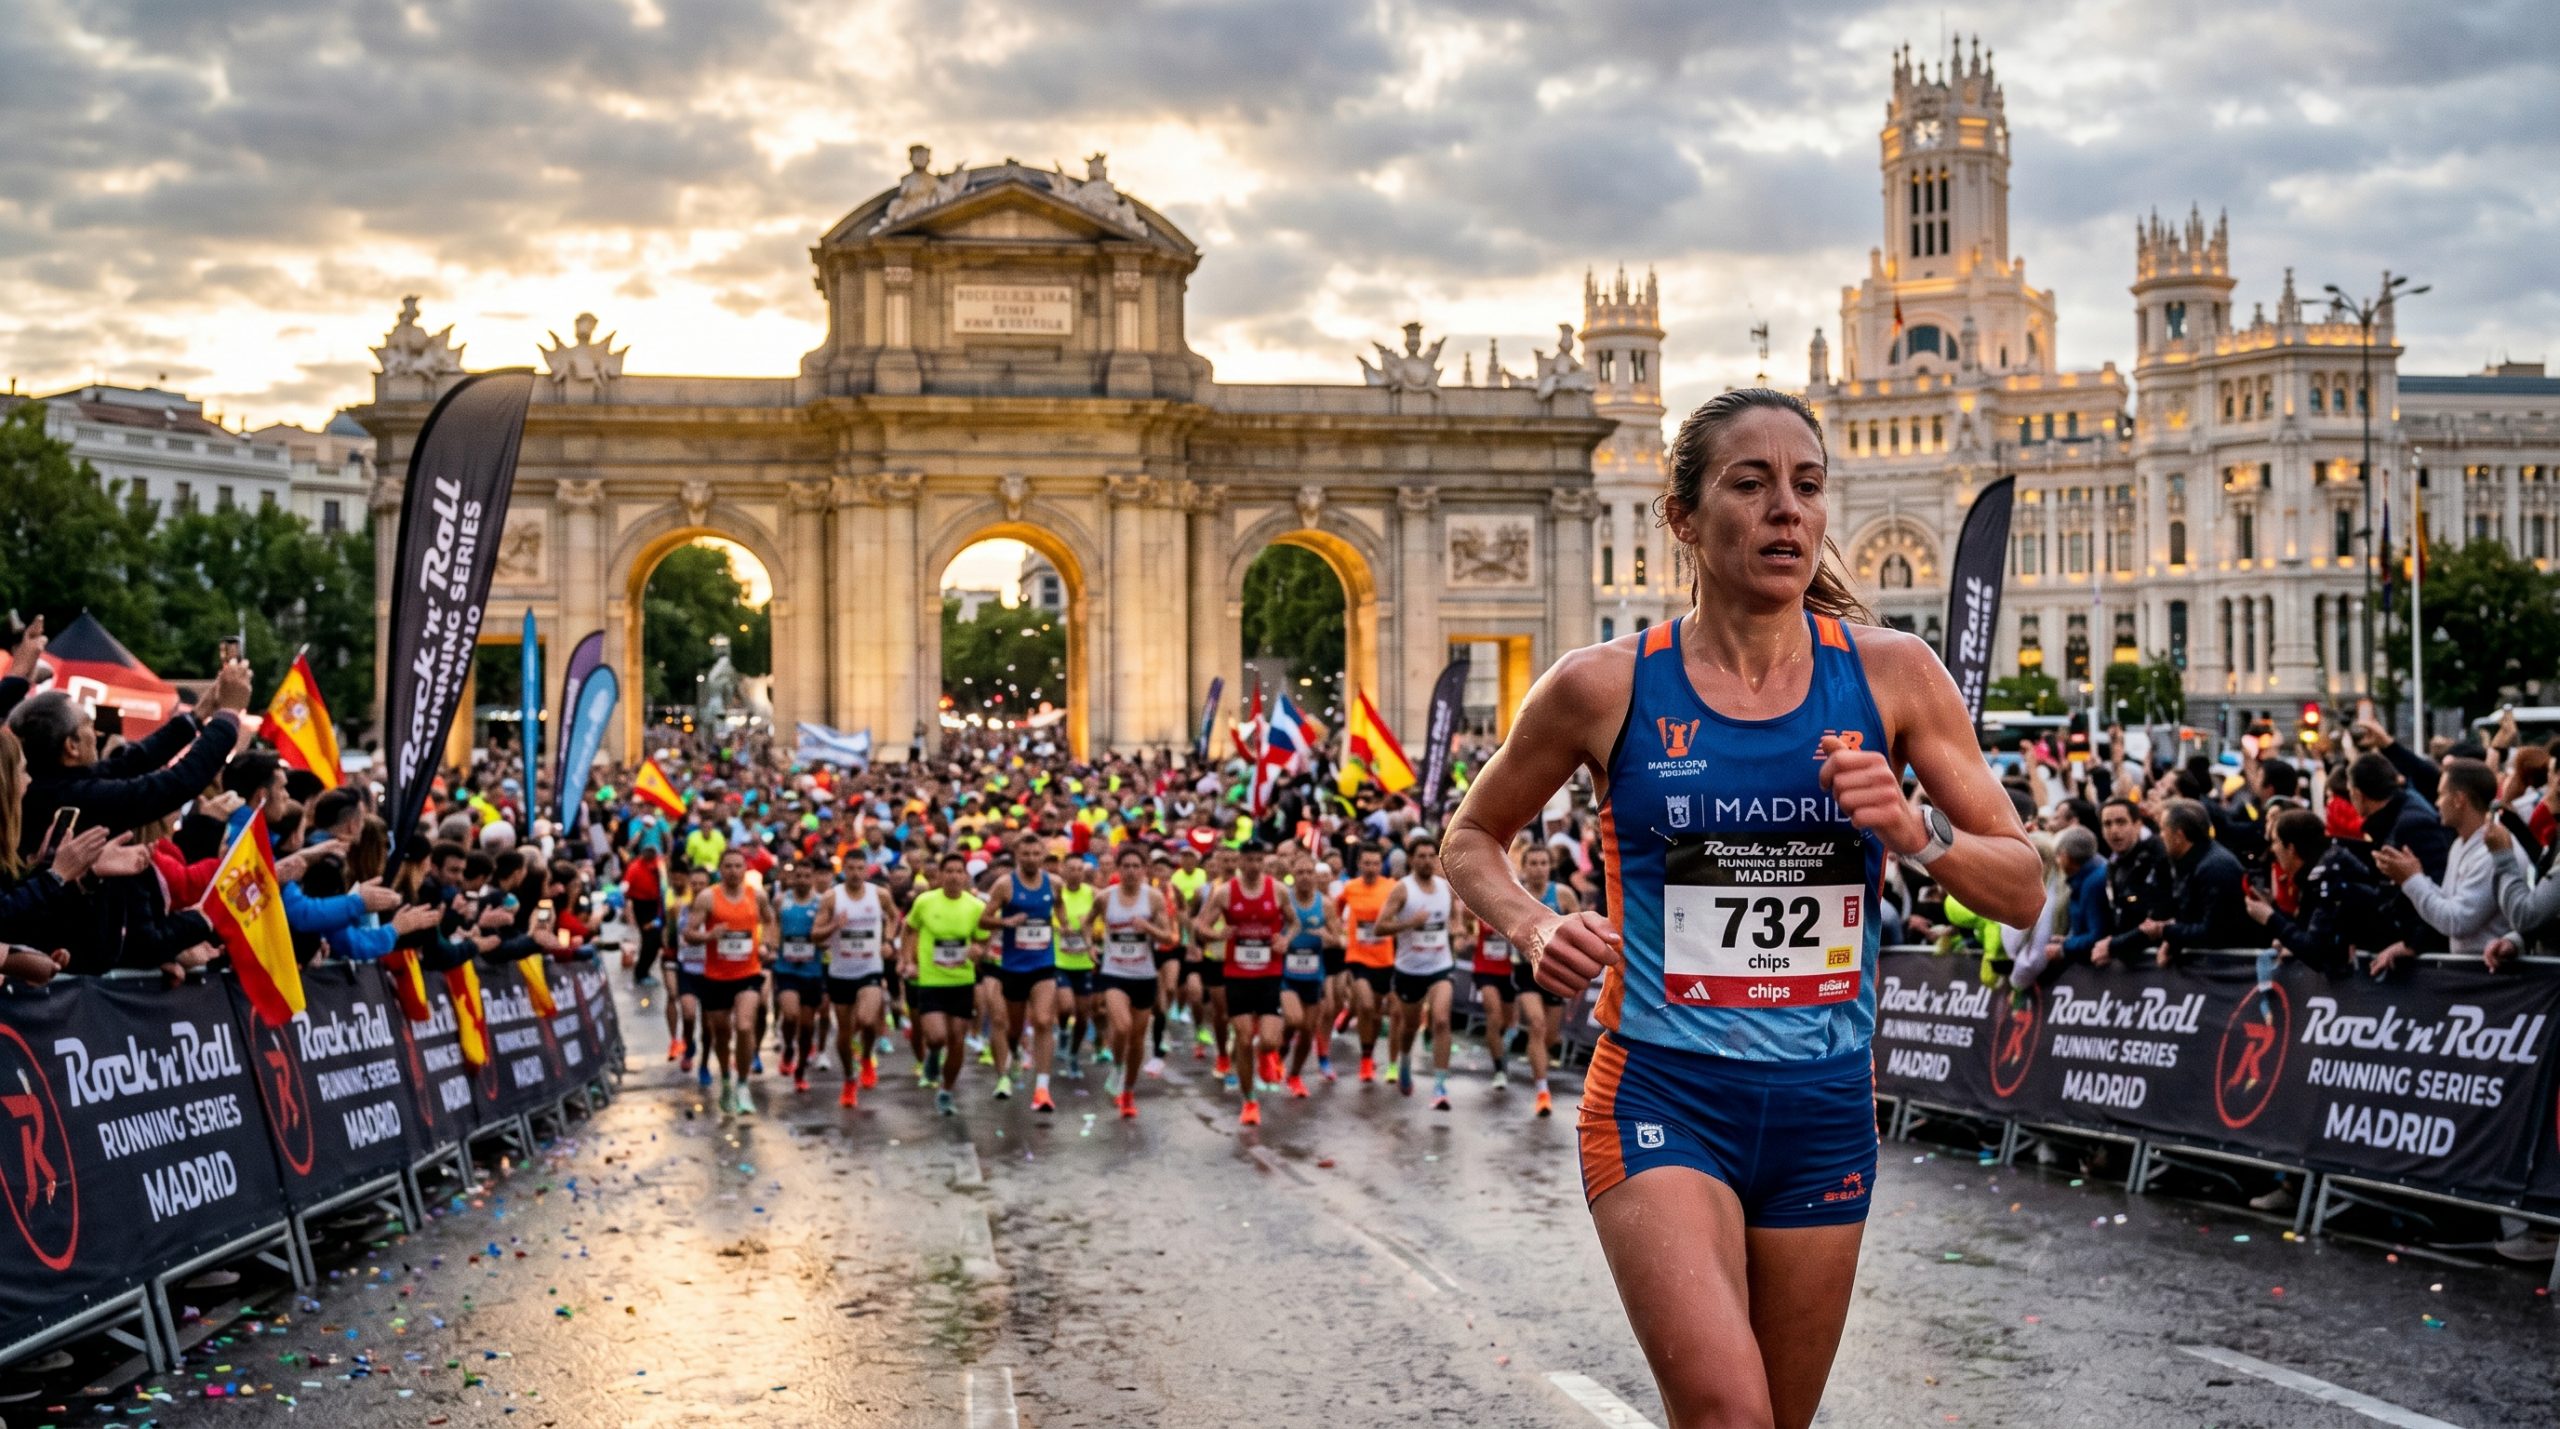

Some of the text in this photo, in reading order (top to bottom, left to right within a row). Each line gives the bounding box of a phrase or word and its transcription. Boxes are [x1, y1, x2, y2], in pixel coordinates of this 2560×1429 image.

[450, 500, 482, 601] SERIES
[1718, 859, 1775, 868] RUNNING
[1735, 870, 1806, 882] MADRID
[1715, 896, 1820, 949] 732
[1748, 953, 1790, 973] chips
[1748, 983, 1790, 1003] chips
[1886, 1048, 1951, 1082] MADRID
[2051, 1034, 2179, 1068] RUNNING SERIES
[2061, 1069, 2147, 1109] MADRID
[2307, 1057, 2504, 1108] RUNNING SERIES
[98, 1094, 242, 1160] RUNNING SERIES
[343, 1100, 401, 1150] MADRID
[2324, 1102, 2456, 1157] MADRID
[143, 1151, 238, 1222] MADRID
